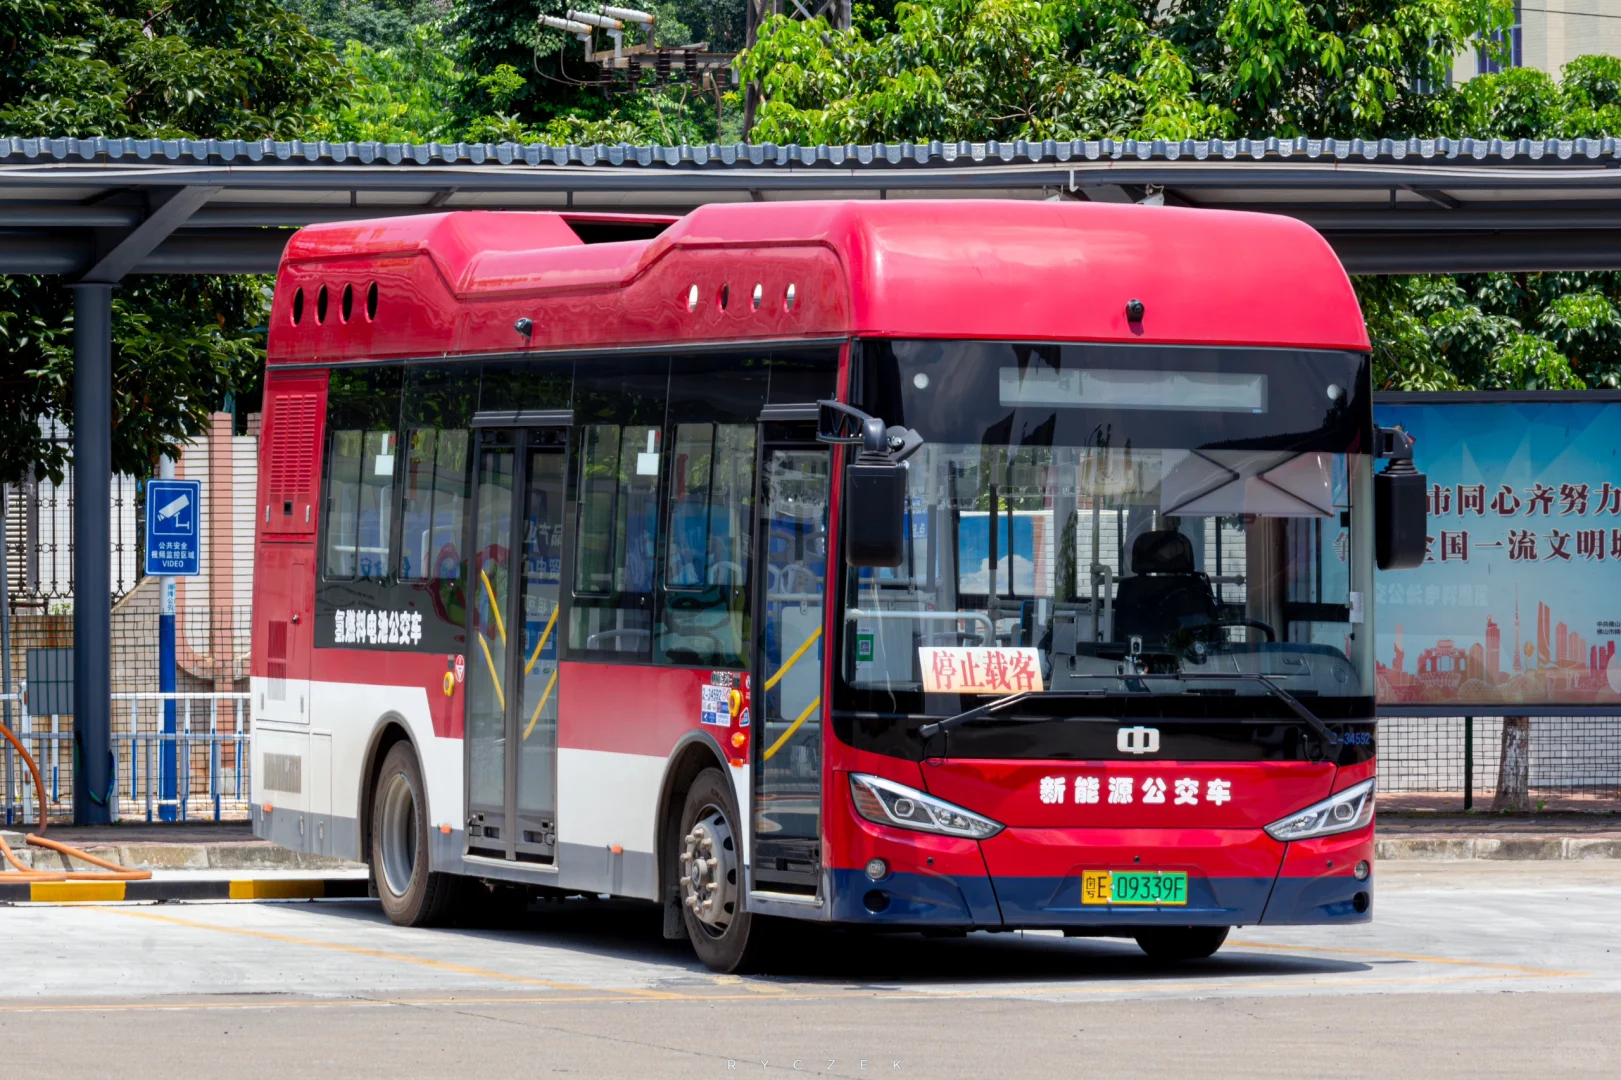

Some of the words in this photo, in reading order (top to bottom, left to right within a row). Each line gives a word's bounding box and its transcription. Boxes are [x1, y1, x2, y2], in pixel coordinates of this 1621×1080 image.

[1425, 482, 1621, 517] 市同心齐努力
[151, 550, 195, 560] 视频监控区域
[158, 541, 188, 550] 公共安全
[162, 560, 184, 568] VIDEO
[334, 609, 423, 646] 氢燃料电池公交车
[931, 650, 1036, 691] 停止载客
[1039, 776, 1231, 806] 新能源公交车
